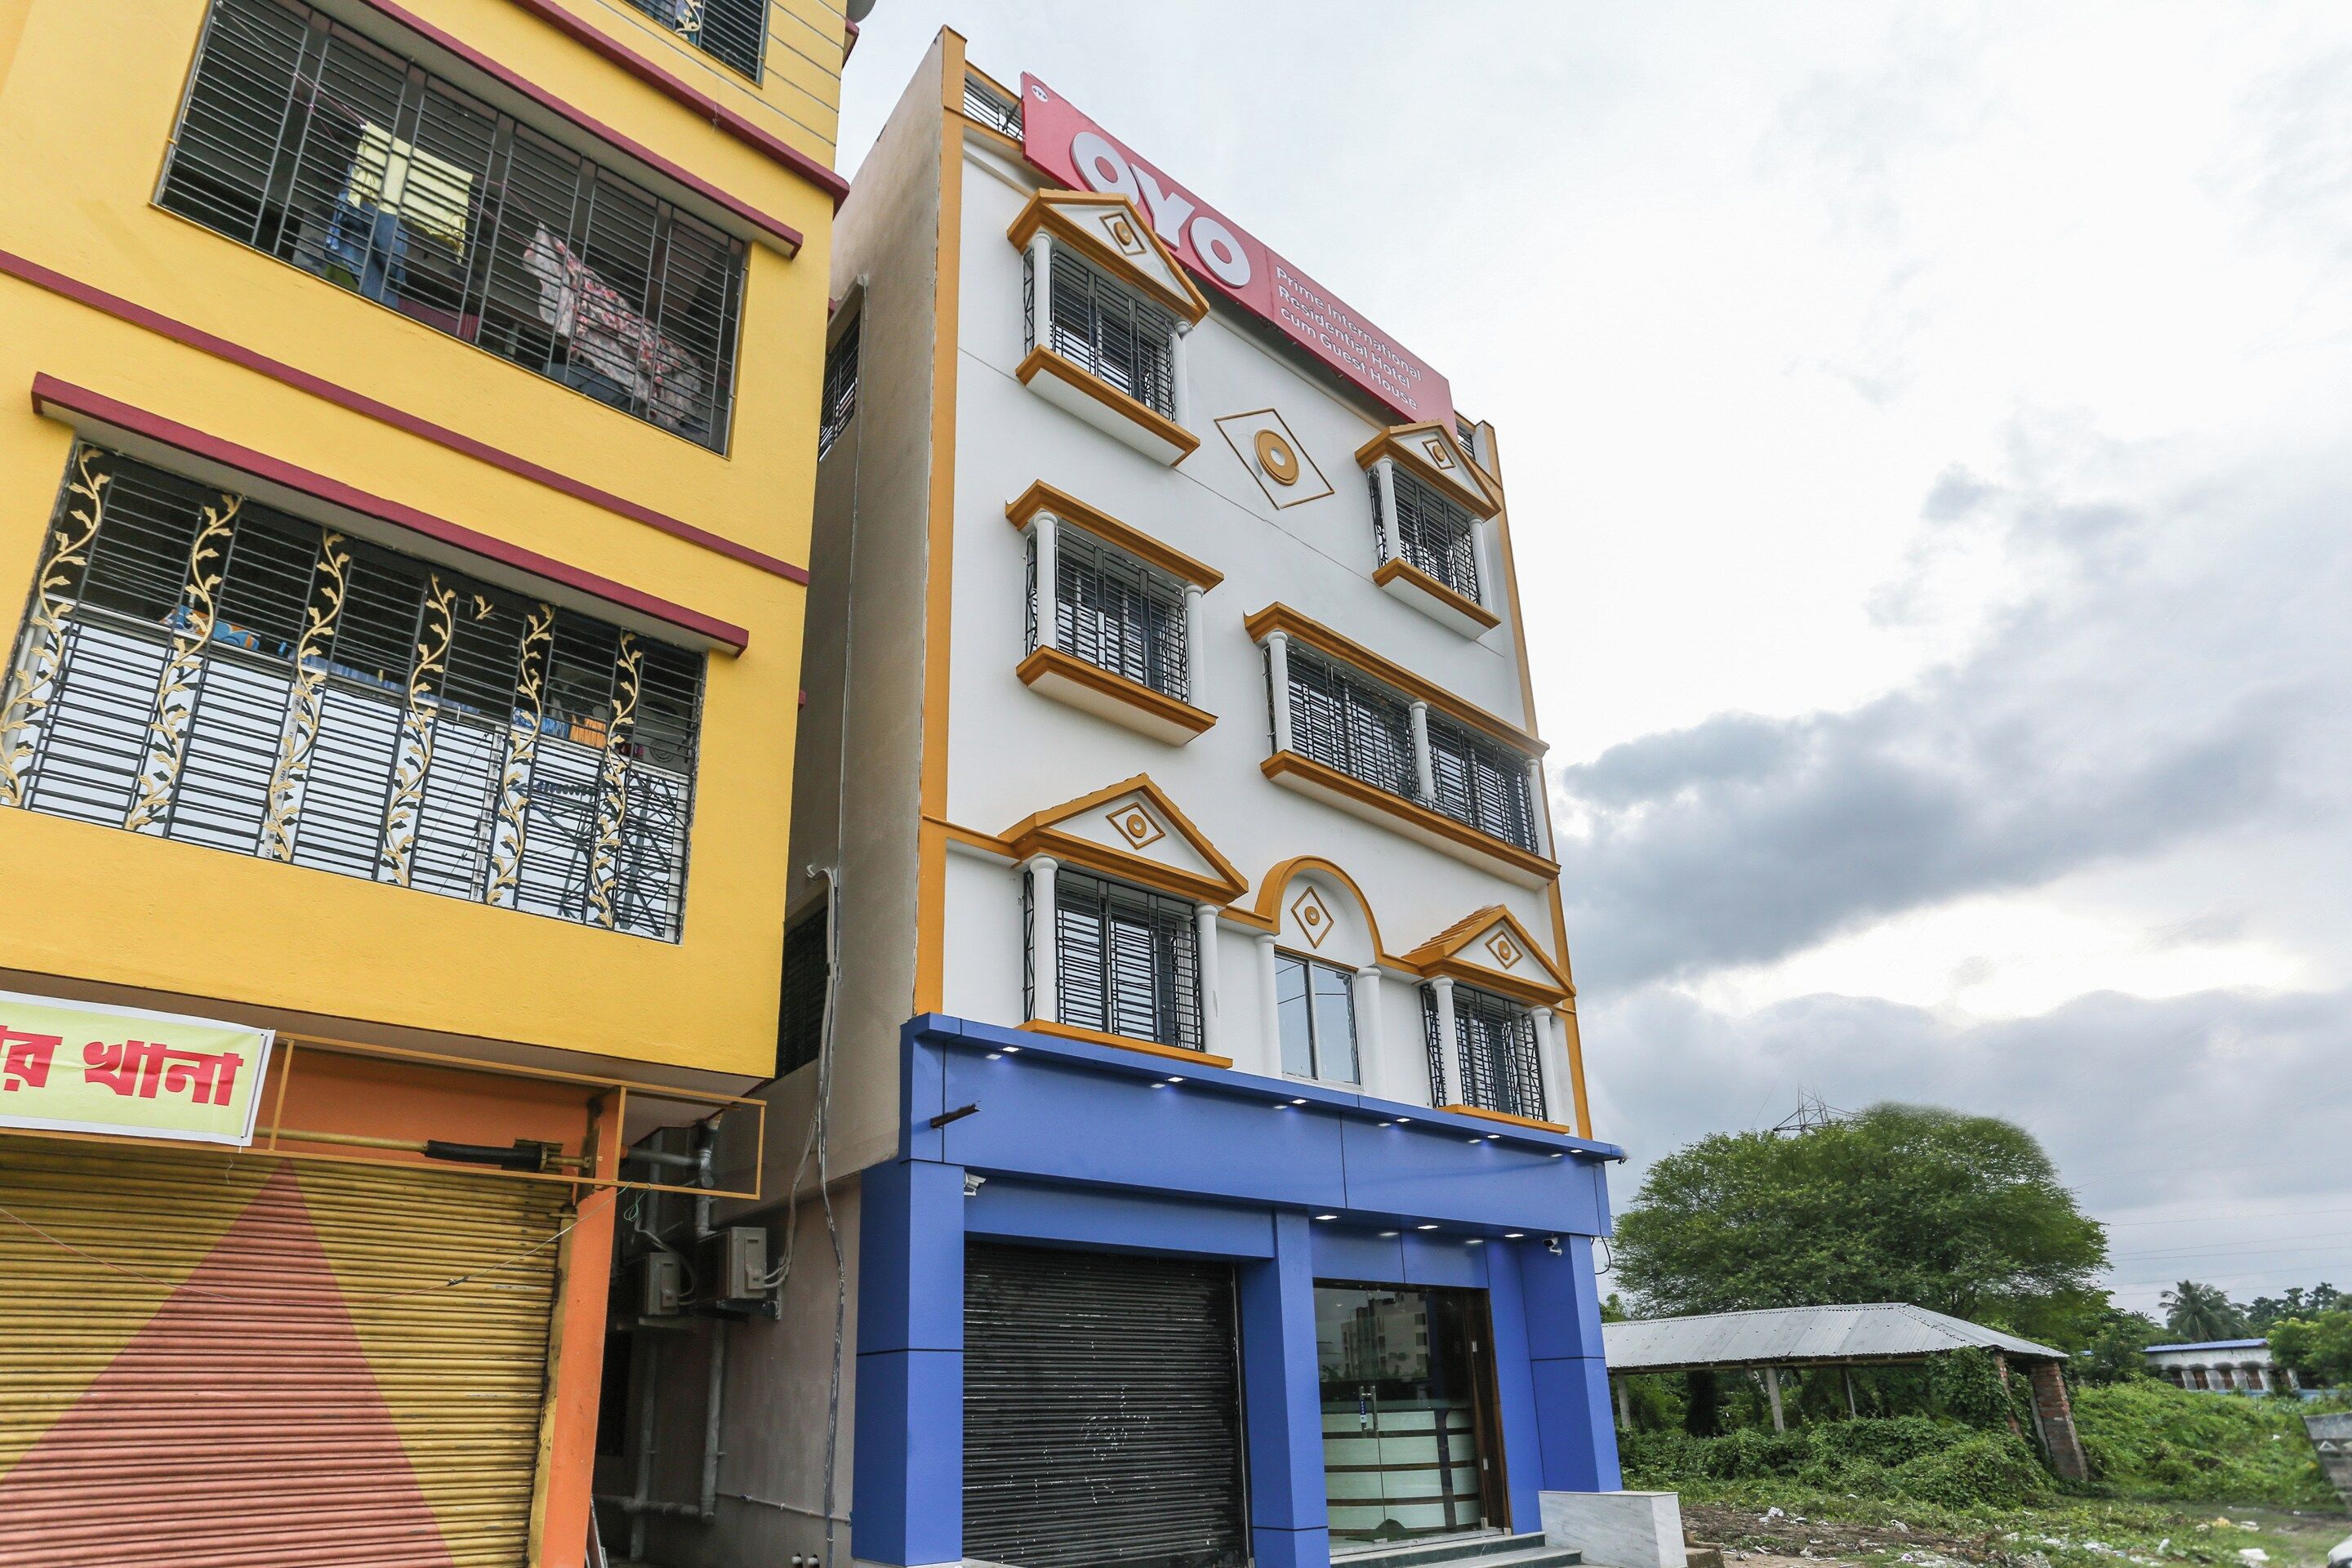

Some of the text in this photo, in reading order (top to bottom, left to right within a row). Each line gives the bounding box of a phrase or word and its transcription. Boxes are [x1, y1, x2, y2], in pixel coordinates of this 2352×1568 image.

[1070, 131, 1251, 287] OYO
[1276, 265, 1422, 381] Prime International
[1278, 284, 1410, 390] Residential Hotel
[1281, 307, 1418, 410] cum Guest House
[83, 1040, 244, 1107] খানা
